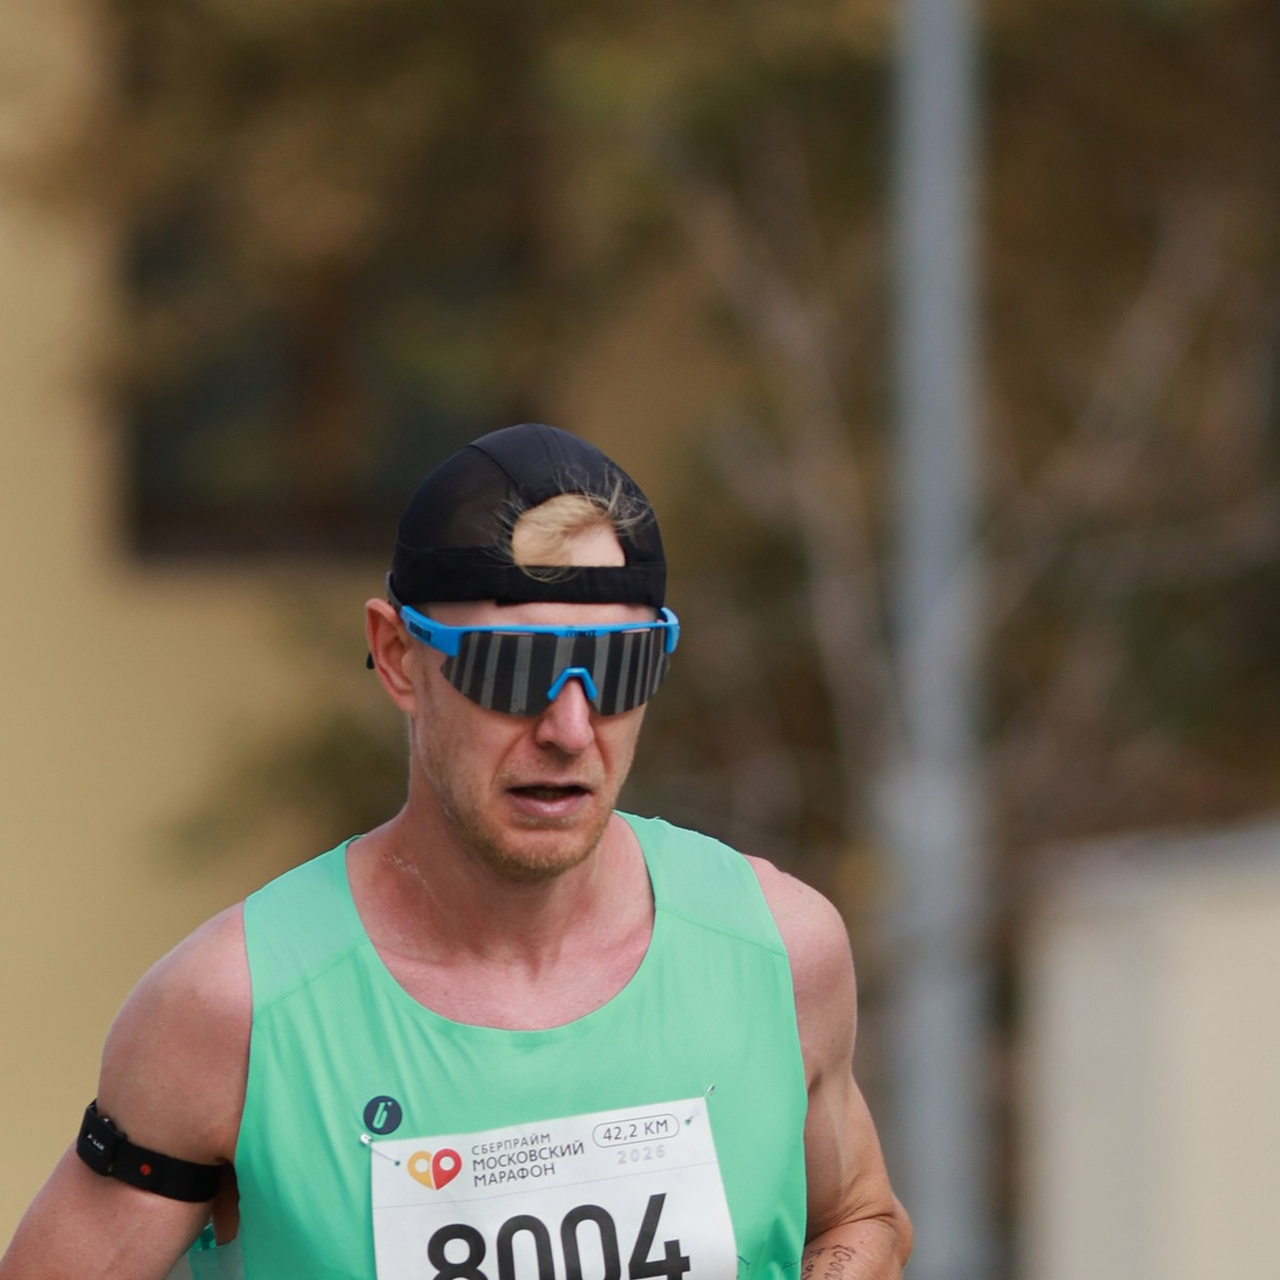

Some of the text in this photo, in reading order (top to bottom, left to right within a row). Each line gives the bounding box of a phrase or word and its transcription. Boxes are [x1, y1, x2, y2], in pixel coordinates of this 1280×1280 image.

[603, 1119, 669, 1141] 42,2 КМ
[471, 1133, 551, 1156] СБЕРПРАЙМ
[473, 1140, 585, 1172] МОСКОВСКИЙ
[474, 1163, 555, 1188] МАРАФОН
